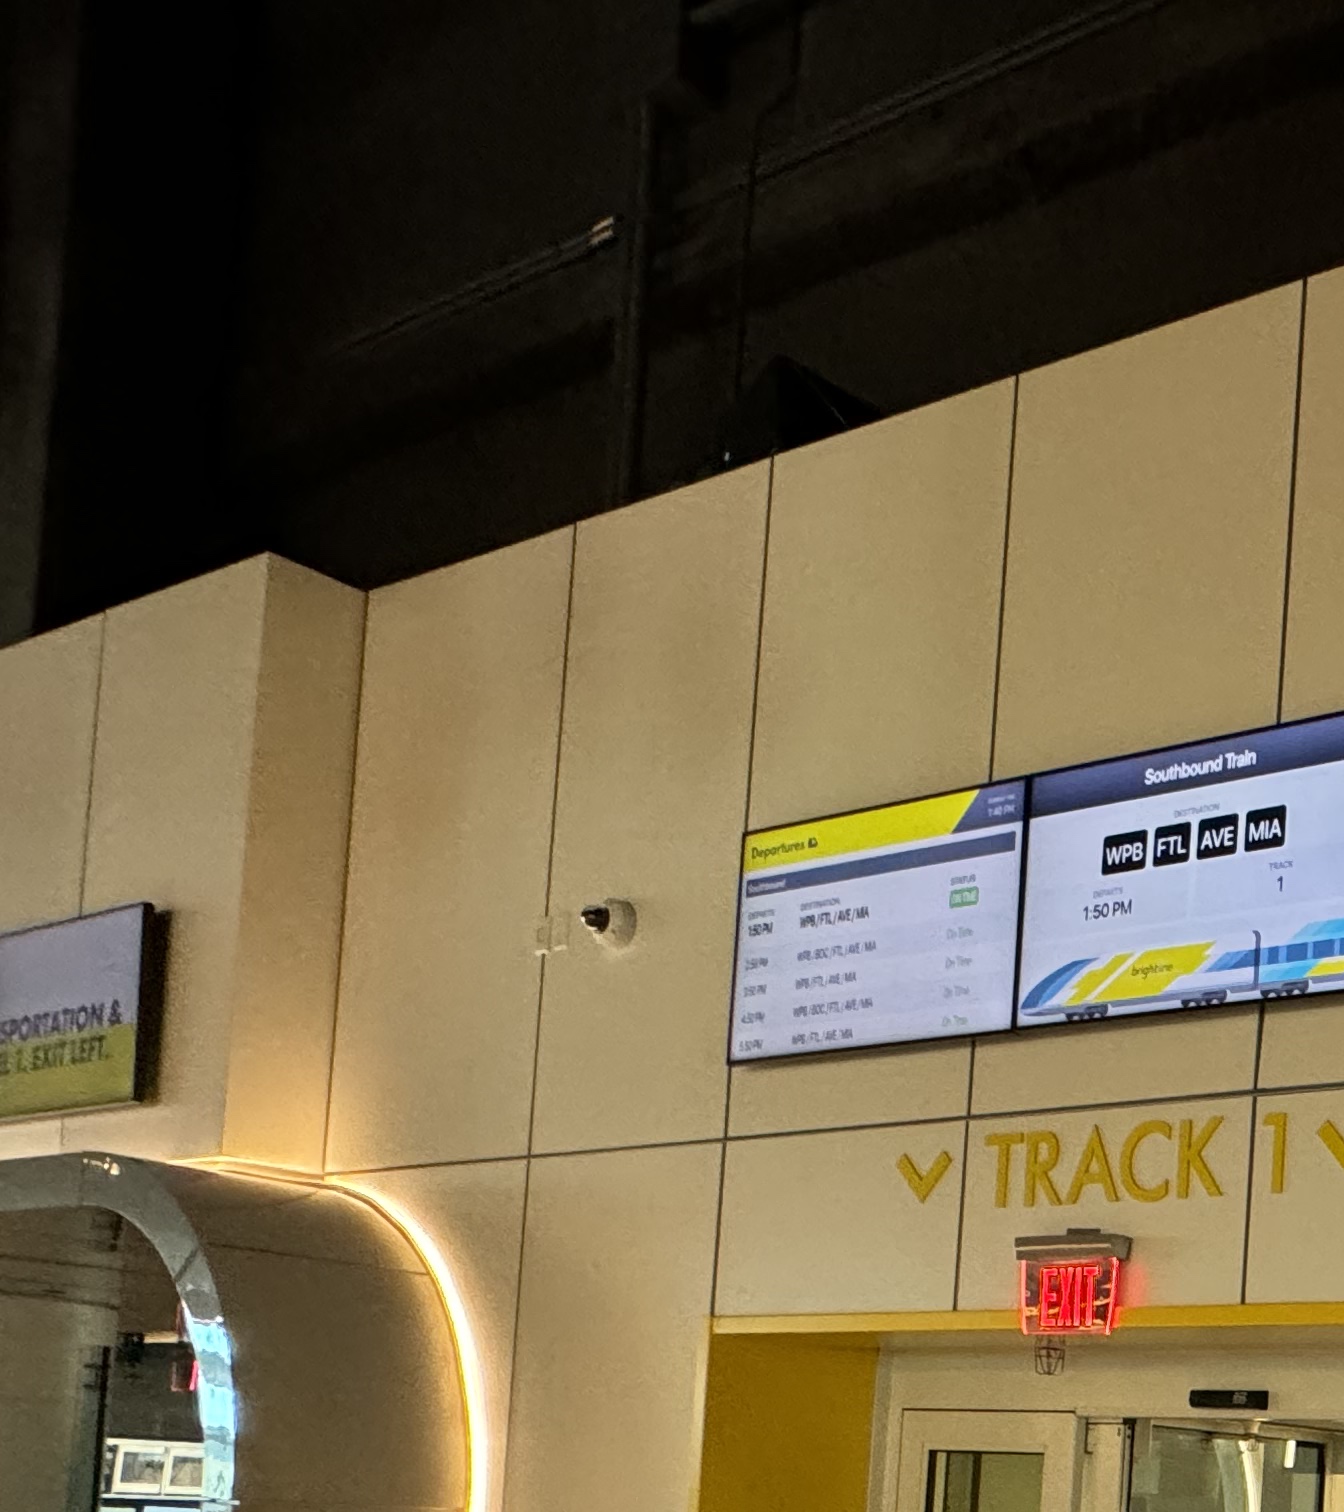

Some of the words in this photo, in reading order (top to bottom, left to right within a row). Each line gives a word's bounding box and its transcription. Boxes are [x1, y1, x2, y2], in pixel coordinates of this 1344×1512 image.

[1144, 756, 1222, 785] Southbound
[1226, 750, 1256, 769] Train
[751, 841, 805, 860] Departures
[1106, 841, 1143, 866] WPB
[1157, 836, 1186, 857] FTL
[1201, 827, 1234, 850] AVE
[1249, 819, 1281, 842] MIA
[1269, 861, 1293, 870] TRACK
[1277, 876, 1283, 892] 1
[1083, 902, 1109, 921] 1:50
[1112, 900, 1132, 916] PM
[985, 1116, 1224, 1208] TRACK
[1263, 1112, 1287, 1194] 1
[1039, 1265, 1100, 1329] EXIT
